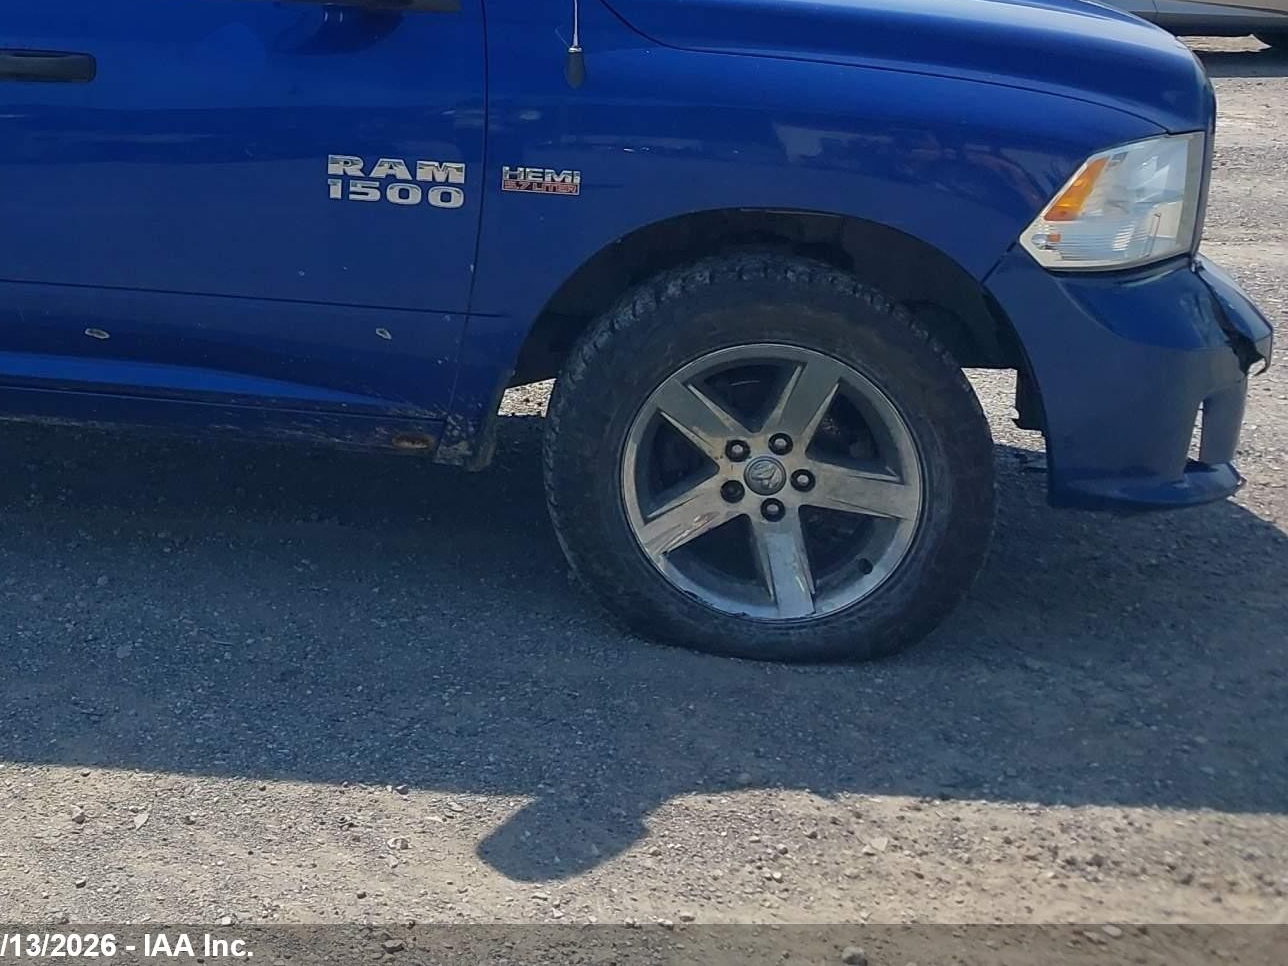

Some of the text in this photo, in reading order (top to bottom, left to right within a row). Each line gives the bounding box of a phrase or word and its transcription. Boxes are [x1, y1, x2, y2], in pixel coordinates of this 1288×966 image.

[327, 154, 466, 184] RAM
[502, 165, 581, 184] HEMI
[327, 178, 465, 209] 1500
[504, 180, 577, 193] 5.7 LITER
